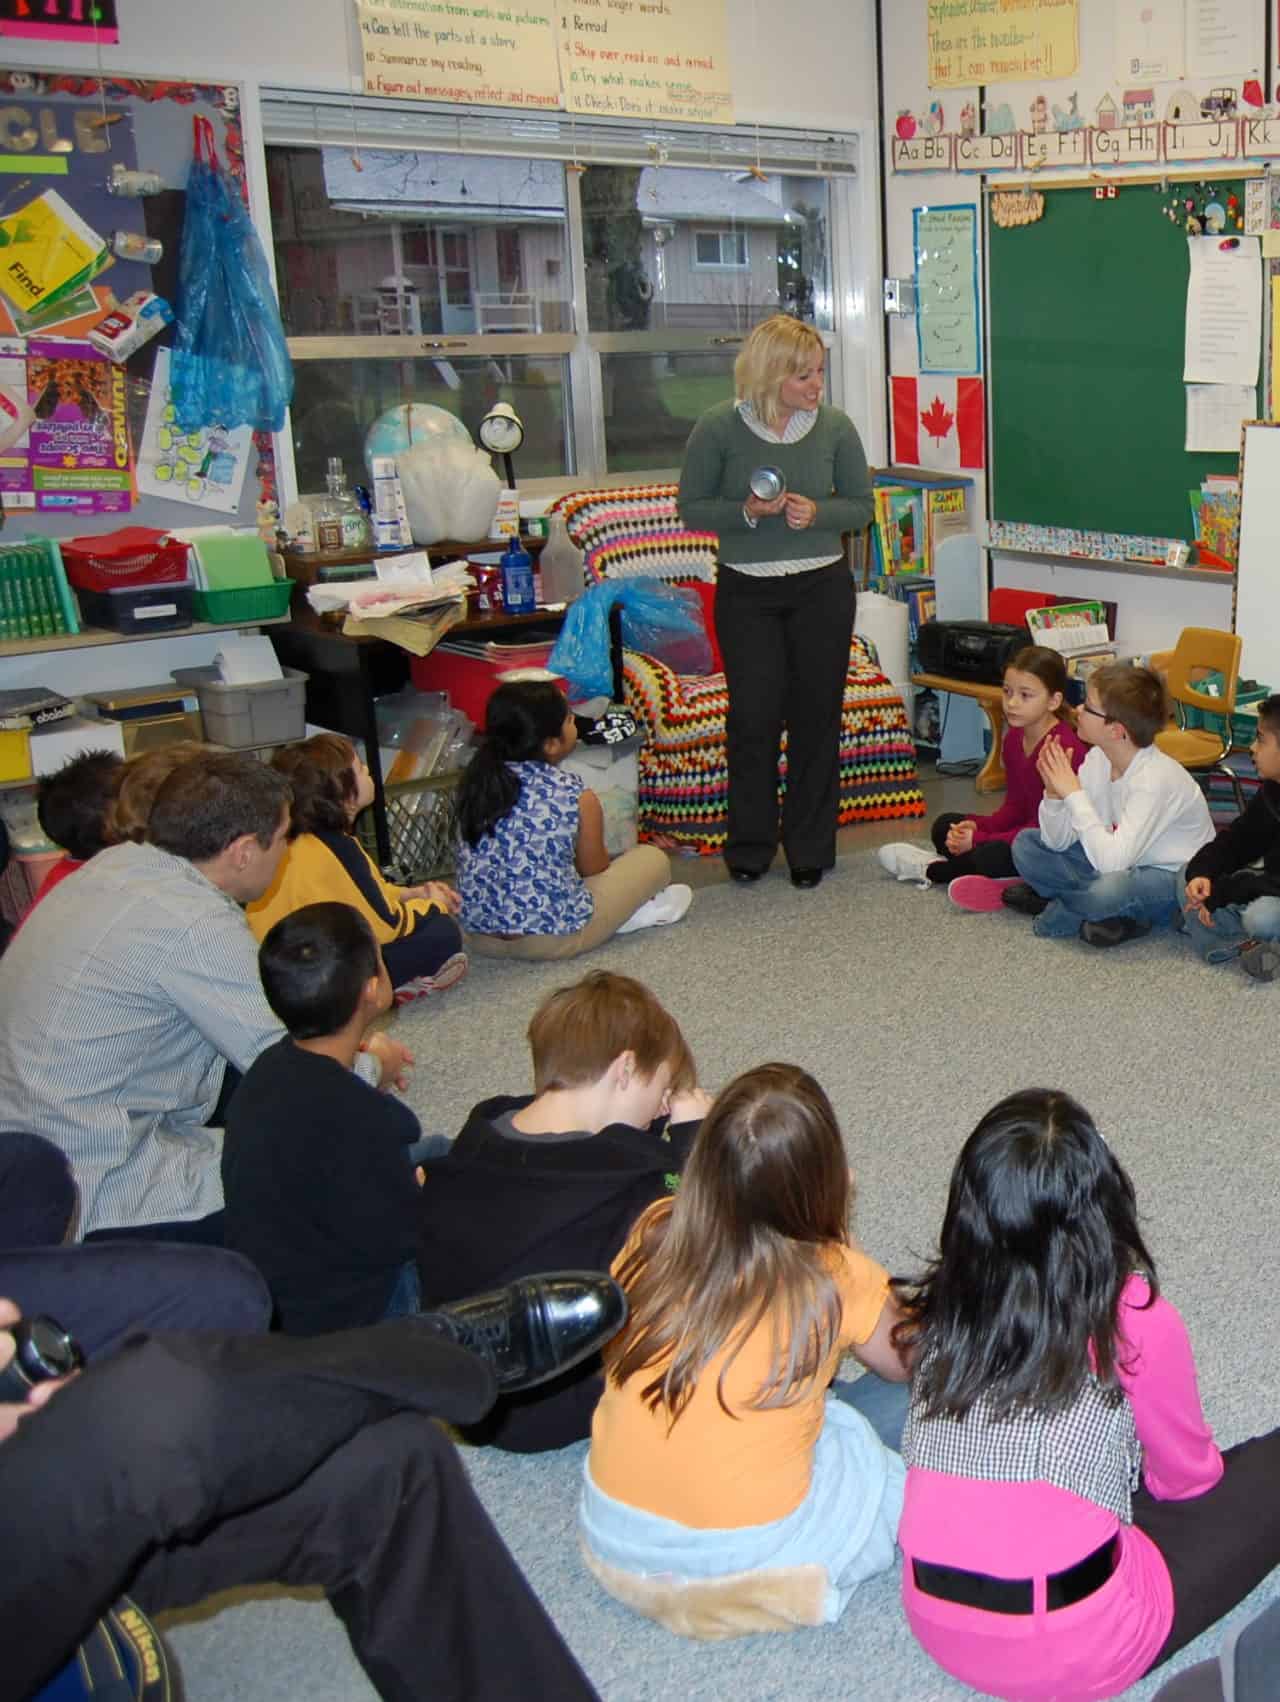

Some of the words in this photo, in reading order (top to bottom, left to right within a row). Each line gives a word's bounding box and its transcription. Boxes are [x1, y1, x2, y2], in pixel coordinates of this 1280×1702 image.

[393, 21, 411, 38] tell
[414, 21, 431, 39] the
[376, 74, 405, 96] Figure
[7, 260, 46, 299] Find
[118, 1610, 161, 1685] Nikon
